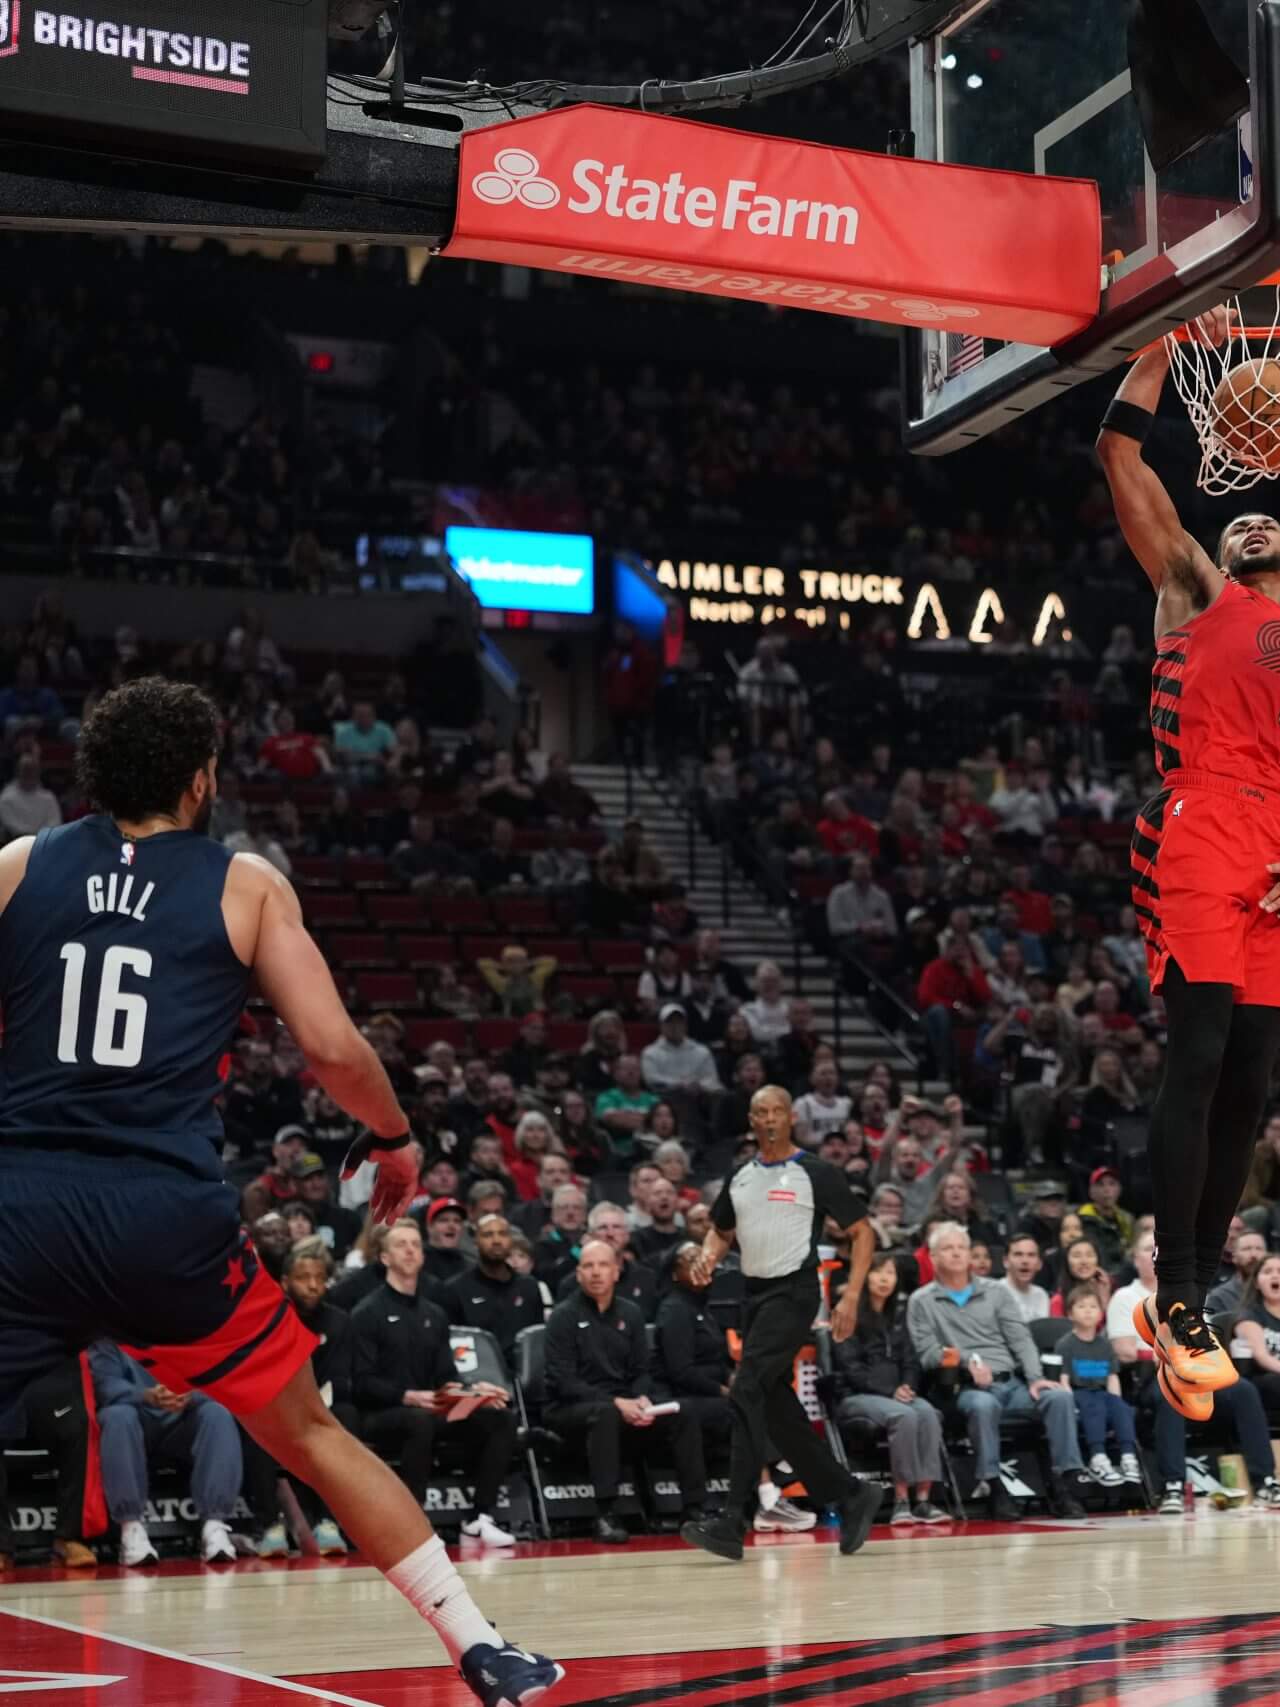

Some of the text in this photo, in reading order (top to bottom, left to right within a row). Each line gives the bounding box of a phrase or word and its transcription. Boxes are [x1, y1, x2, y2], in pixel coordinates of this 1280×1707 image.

[34, 9, 250, 77] BRIGHTSIDE
[643, 559, 904, 605] AIMLER TRUCK
[86, 871, 156, 922] GILL
[57, 942, 153, 1068] 16
